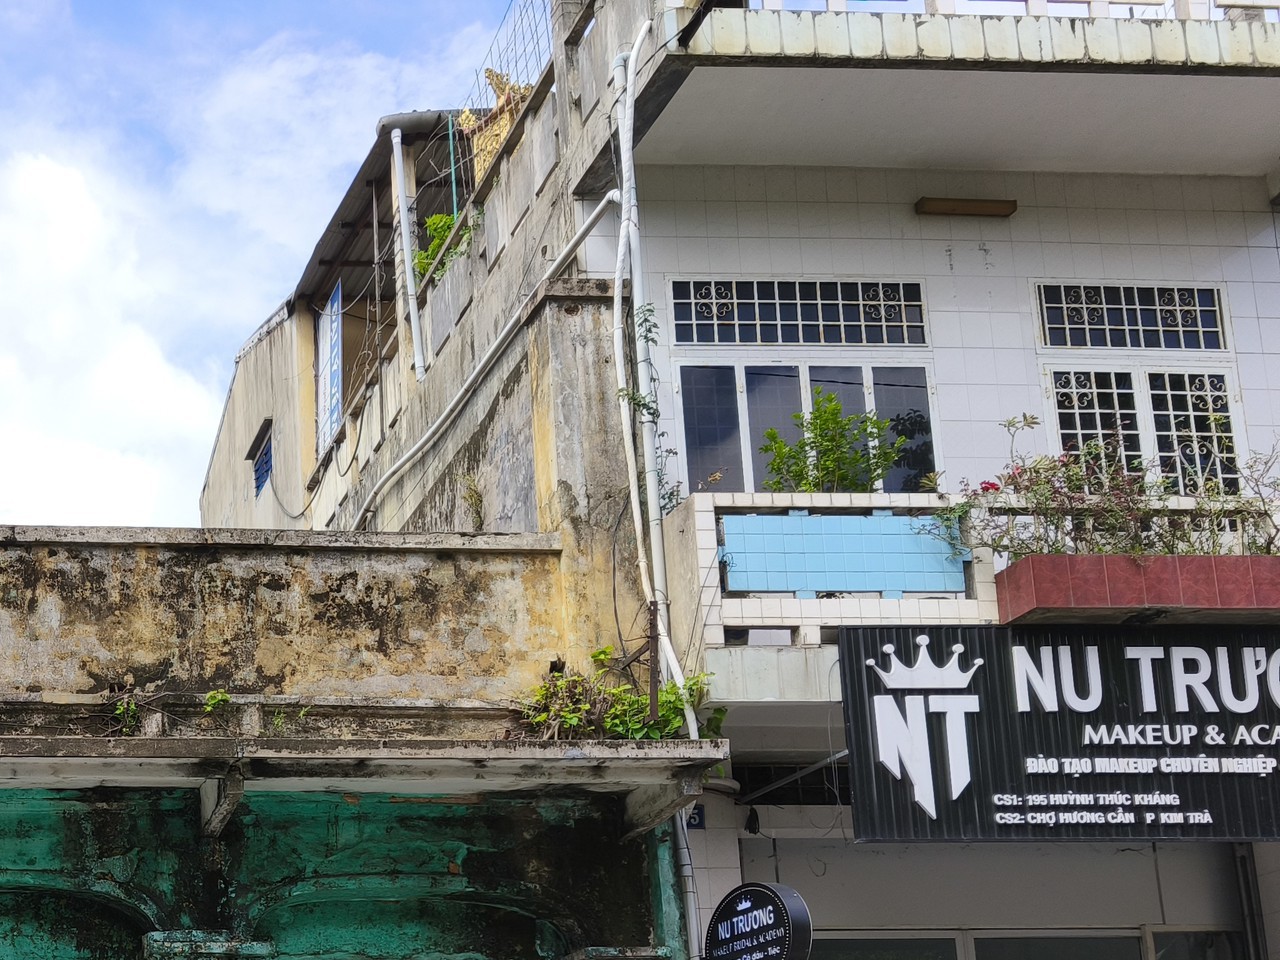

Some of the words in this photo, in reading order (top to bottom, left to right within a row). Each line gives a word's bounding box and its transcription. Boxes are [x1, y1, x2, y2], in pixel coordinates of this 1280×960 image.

[1012, 645, 1103, 713] NU
[1084, 725, 1197, 744] MAKEUP
[1205, 725, 1226, 744] &
[874, 694, 980, 820] NT
[1026, 754, 1059, 774] ĐÀO
[1061, 758, 1092, 777] TẠO
[1095, 758, 1157, 774] MAKEUP
[1160, 753, 1219, 773] CHUYÊN
[1221, 754, 1277, 777] NGHIỆP
[993, 794, 1022, 805] CS1:
[1026, 795, 1047, 805] 195
[1049, 790, 1094, 805] HUỲNH
[1097, 791, 1131, 805] THÚC
[1134, 791, 1180, 805] KHÁNG
[995, 812, 1025, 824] CS2:
[1027, 811, 1056, 827] CHỢ
[1059, 811, 1105, 823] HƯƠNG
[1146, 813, 1155, 823] P
[1160, 813, 1184, 823] KIM
[1186, 809, 1213, 823] TRÀ
[718, 921, 731, 940] NU
[732, 905, 774, 935] TRƯƠNG
